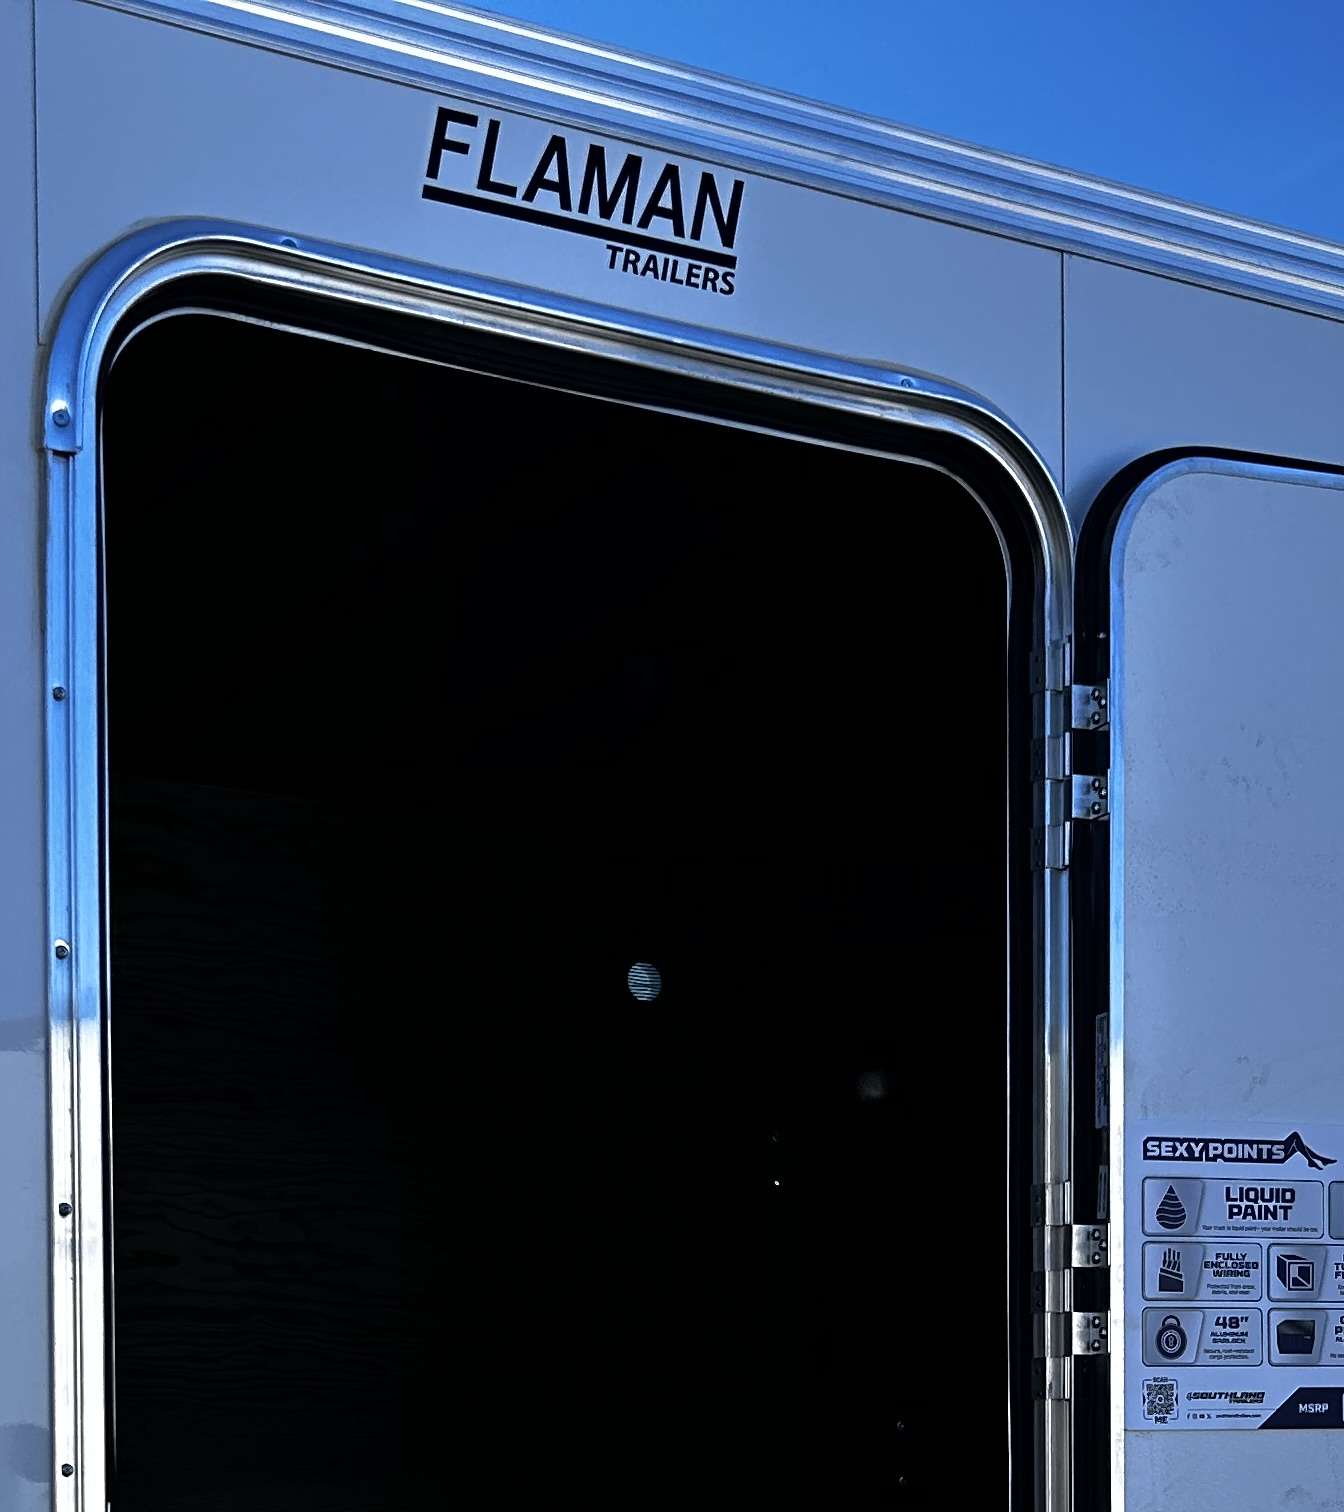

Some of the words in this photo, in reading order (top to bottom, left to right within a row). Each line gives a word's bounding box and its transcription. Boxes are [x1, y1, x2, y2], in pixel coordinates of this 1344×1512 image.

[425, 106, 744, 249] FLAMAN
[606, 244, 736, 295] TRAILERS
[1146, 1140, 1204, 1158] SEXY
[1208, 1143, 1285, 1161] POINTS
[1225, 1186, 1296, 1204] LIQUID
[1228, 1204, 1294, 1221] PAINT
[1215, 1252, 1248, 1261] FULLY
[1203, 1261, 1259, 1270] ENCLOSED
[1212, 1269, 1251, 1278] WIRING
[1214, 1316, 1249, 1329] 48"
[1192, 1391, 1266, 1400] SOUTHLAND
[1298, 1402, 1329, 1414] MSRP
[1154, 1415, 1169, 1425] ME
